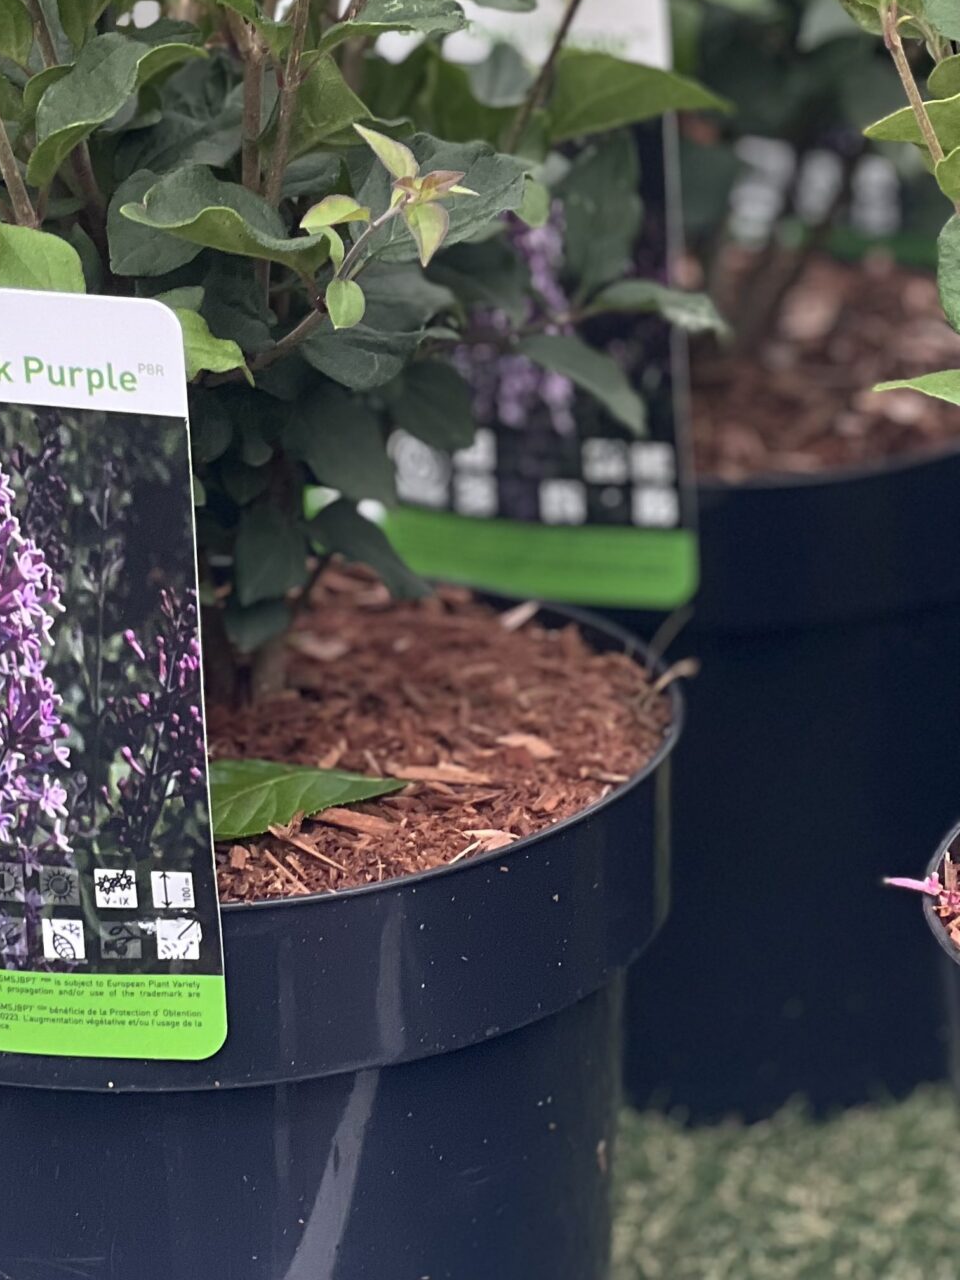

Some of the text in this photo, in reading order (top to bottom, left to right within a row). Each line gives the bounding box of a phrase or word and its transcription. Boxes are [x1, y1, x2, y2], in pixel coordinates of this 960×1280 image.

[24, 356, 137, 396] Purple
[64, 980, 93, 988] subject
[96, 980, 104, 988] to
[106, 980, 146, 990] European
[148, 980, 170, 988] Plant
[172, 980, 200, 990] Variety
[7, 986, 54, 995] propagation
[58, 988, 84, 997] and/or
[122, 990, 135, 998] the
[139, 990, 182, 999] trademark
[188, 991, 201, 999] are
[109, 1008, 151, 1017] Protection
[182, 1020, 193, 1028] de
